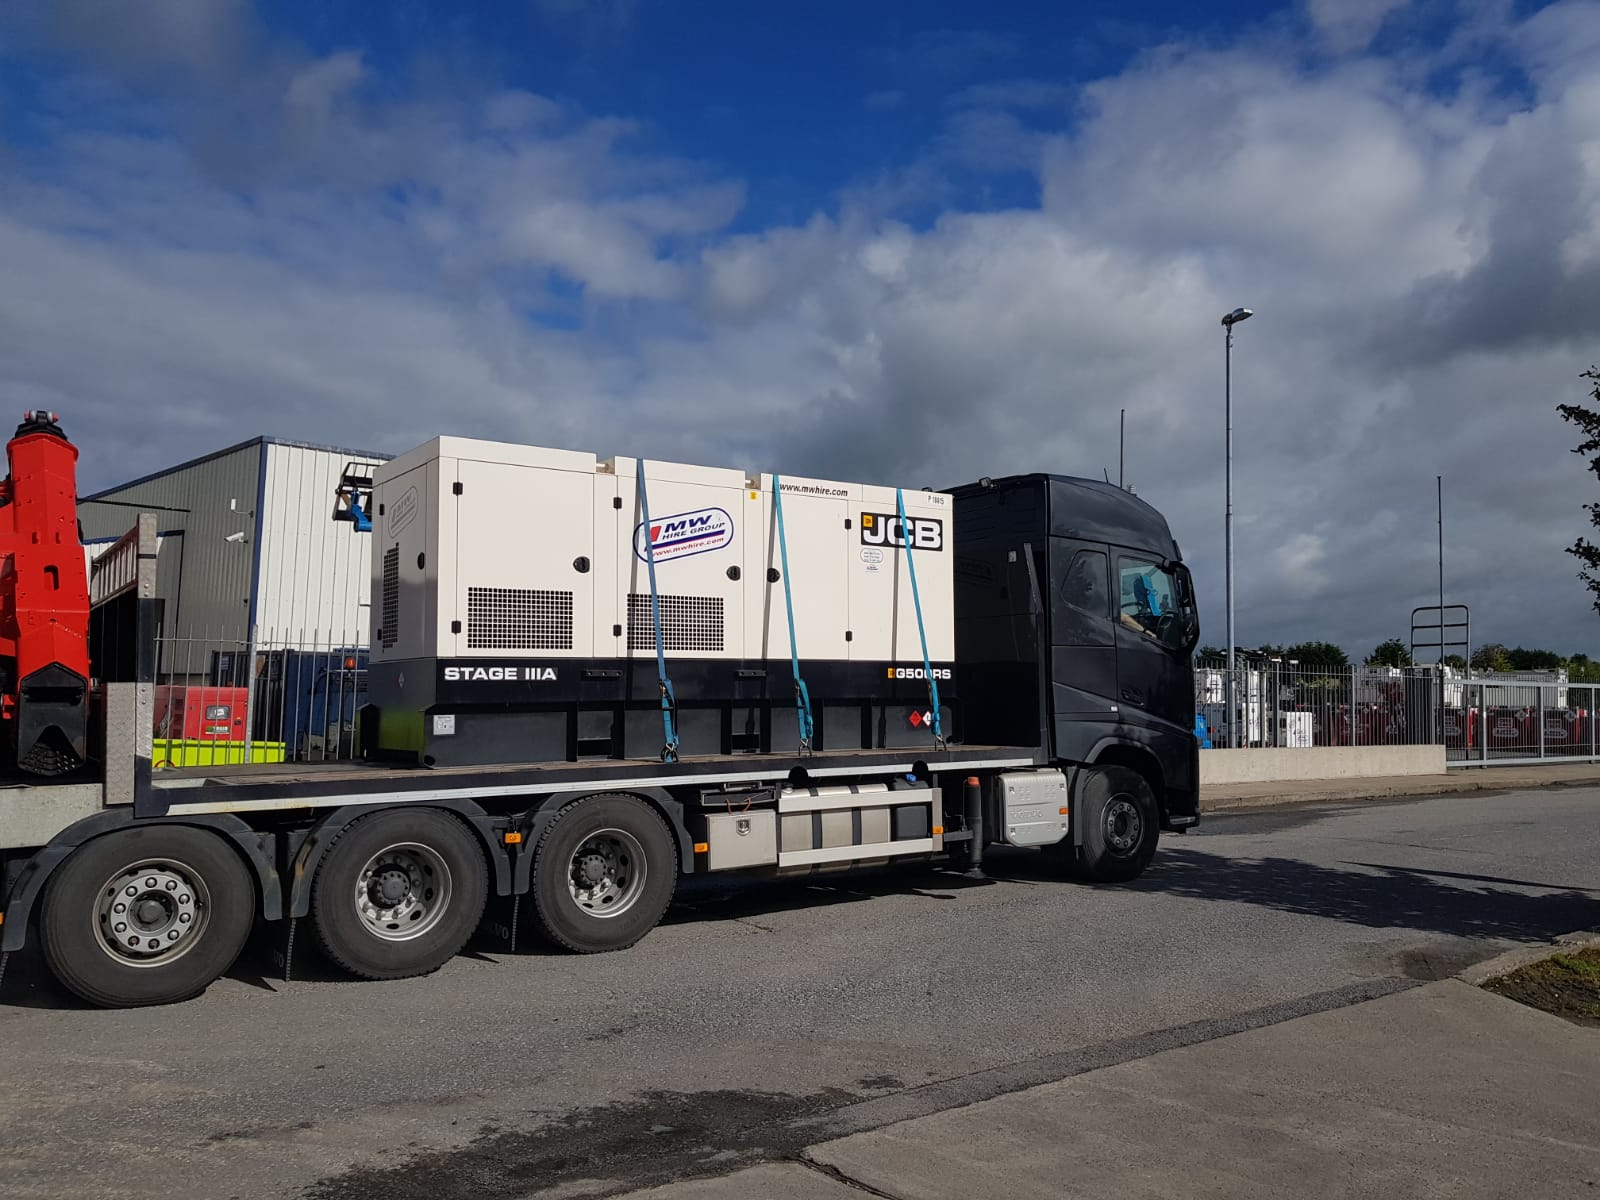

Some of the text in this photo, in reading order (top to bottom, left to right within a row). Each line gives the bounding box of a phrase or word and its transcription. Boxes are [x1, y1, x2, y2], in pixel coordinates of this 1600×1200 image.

[779, 482, 848, 497] www.mwhire.com
[662, 522, 725, 540] HIRE GROUP
[664, 515, 712, 533] MW
[863, 516, 941, 548] JCB
[444, 667, 557, 681] STAGE IIIA
